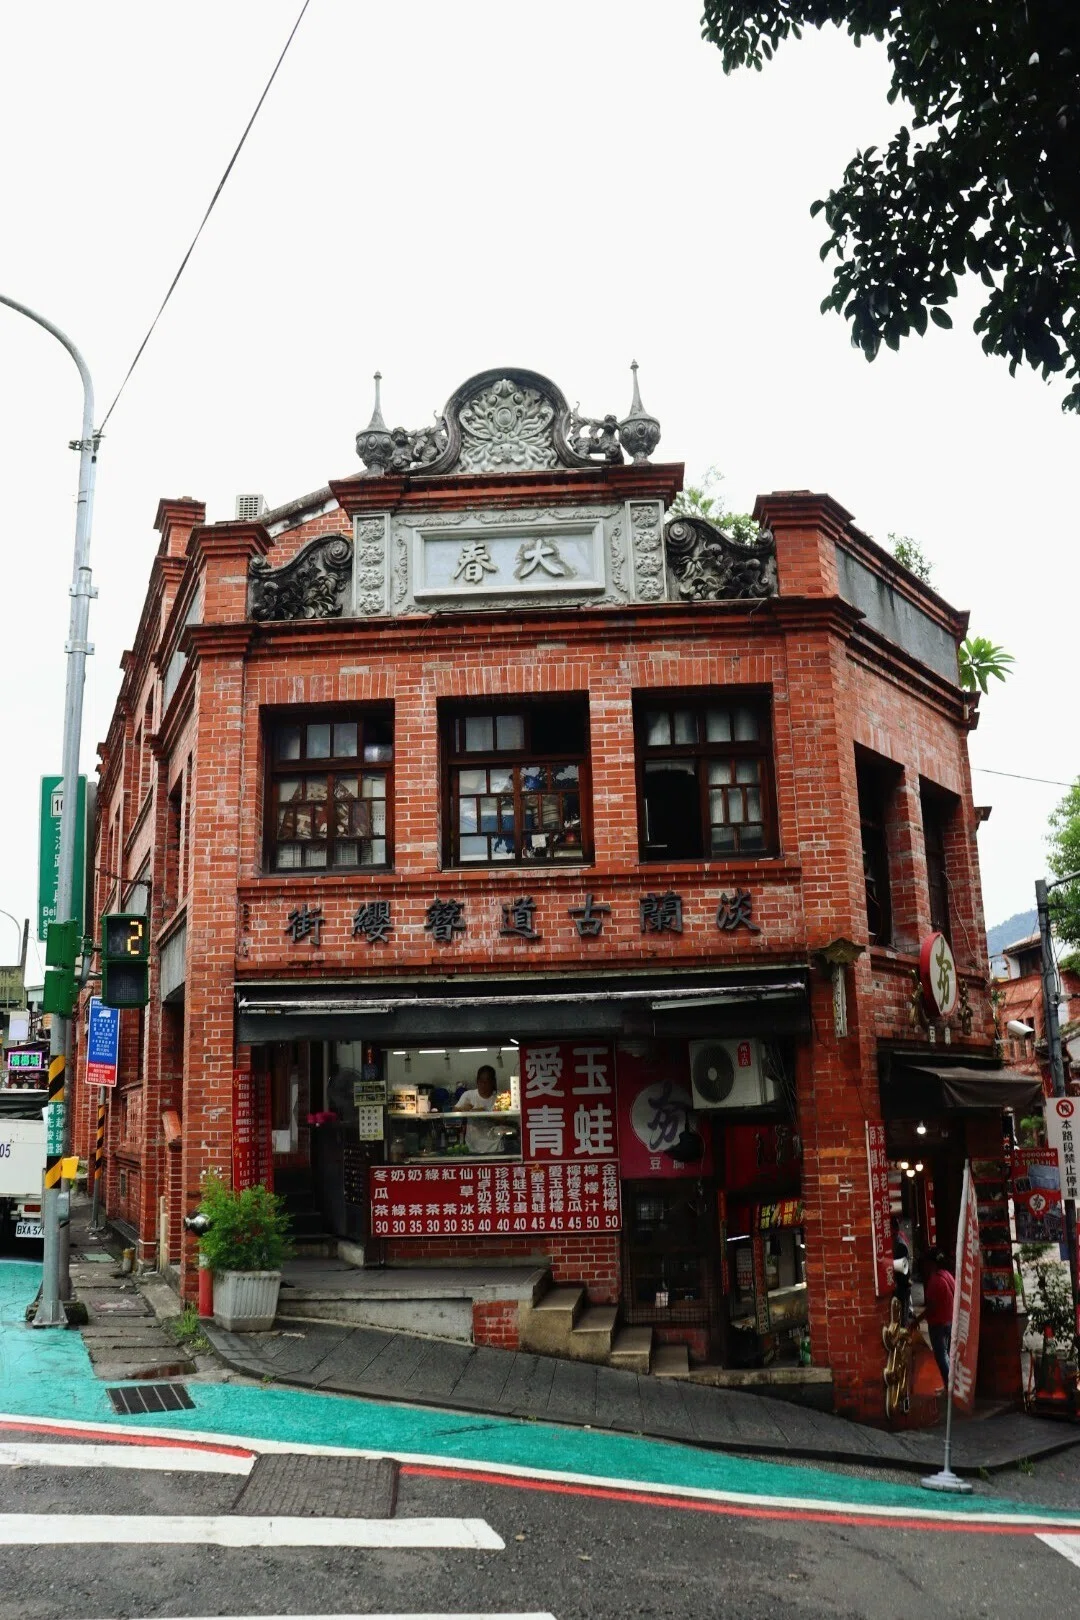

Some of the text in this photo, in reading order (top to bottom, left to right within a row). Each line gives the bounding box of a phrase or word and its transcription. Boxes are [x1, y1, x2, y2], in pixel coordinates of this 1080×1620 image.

[127, 921, 143, 955] 2
[525, 1045, 612, 1099] 愛玉
[526, 1102, 614, 1157] 青蛙
[1061, 1119, 1078, 1198] 本路段禁止停車
[374, 1170, 389, 1233] 冬瓜茶 30
[390, 1169, 406, 1233] 奶綠 30
[408, 1169, 423, 1233] 奶茶 35
[425, 1169, 440, 1232] 綠茶 30
[442, 1168, 457, 1232] 紅茶 30
[459, 1168, 475, 1232] 仙草冰 35
[478, 1219, 491, 1232] 40
[495, 1167, 510, 1231] 珍珠奶茶 40
[513, 1166, 528, 1231] 青蛙下蛋 40
[531, 1171, 546, 1230] 愛玉青蛙 45
[548, 1165, 564, 1229] 愛玉檸檬 45
[566, 1164, 583, 1229] 檸檬冬瓜 45
[584, 1164, 600, 1228] 檸檬汁 50
[602, 1163, 618, 1228] 金桔檸檬 50
